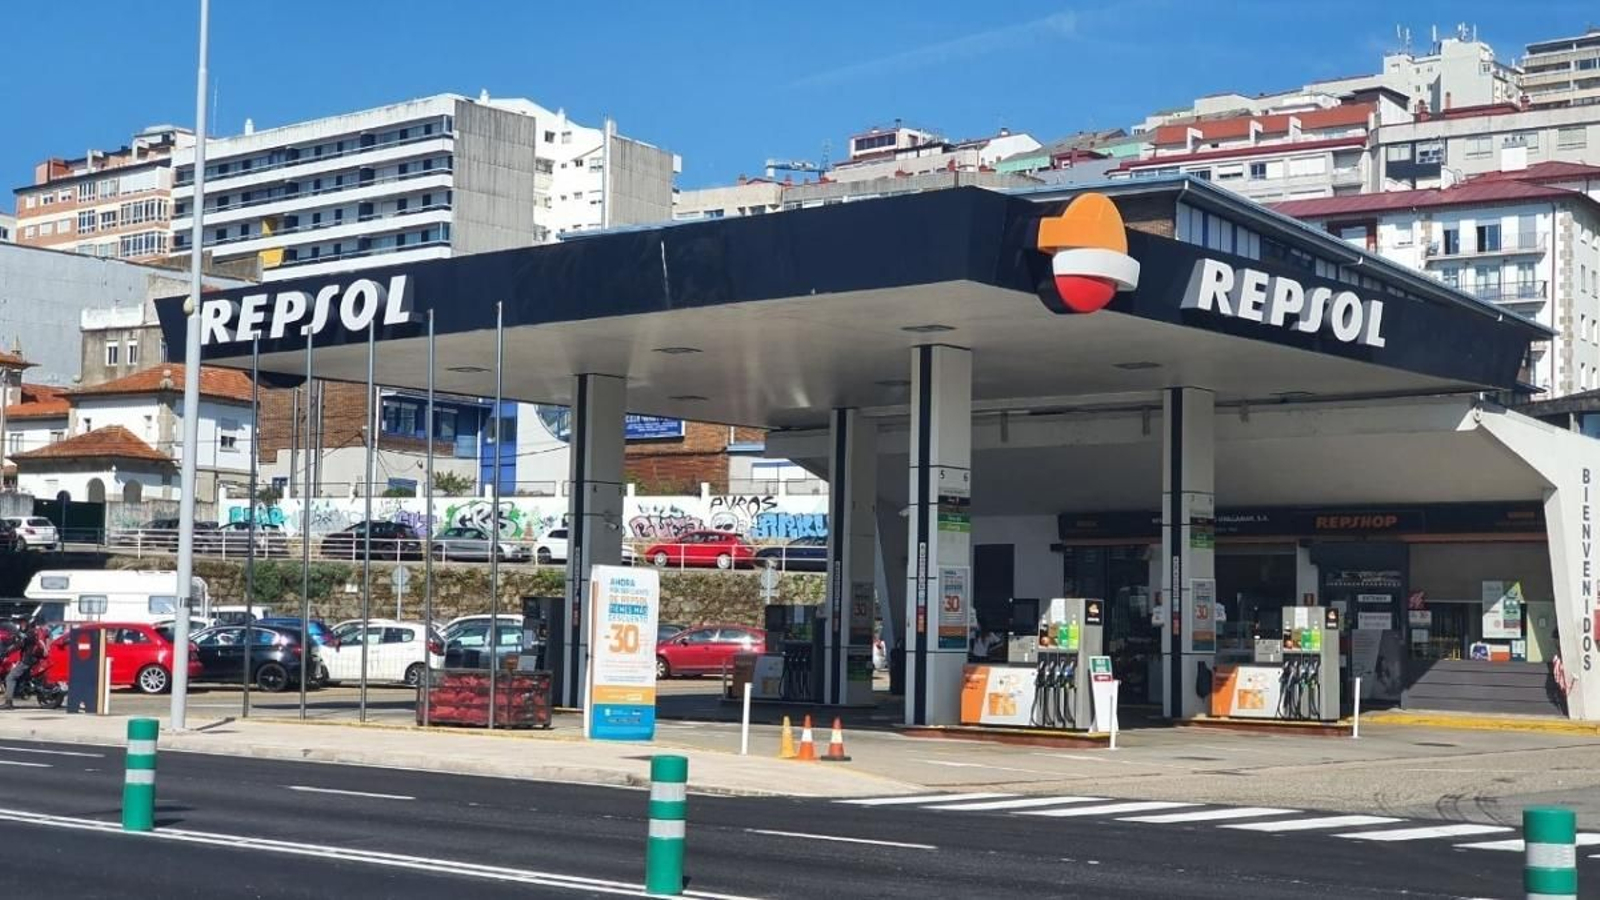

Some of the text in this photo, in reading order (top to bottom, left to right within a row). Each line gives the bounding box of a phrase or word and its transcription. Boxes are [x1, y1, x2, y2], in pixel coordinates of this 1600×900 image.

[200, 274, 411, 345] REPSOL
[1197, 257, 1386, 348] REPSOL
[1315, 515, 1398, 529] REPSHOP
[610, 577, 636, 587] AHORA
[1582, 468, 1592, 671] BIENVENIDOS
